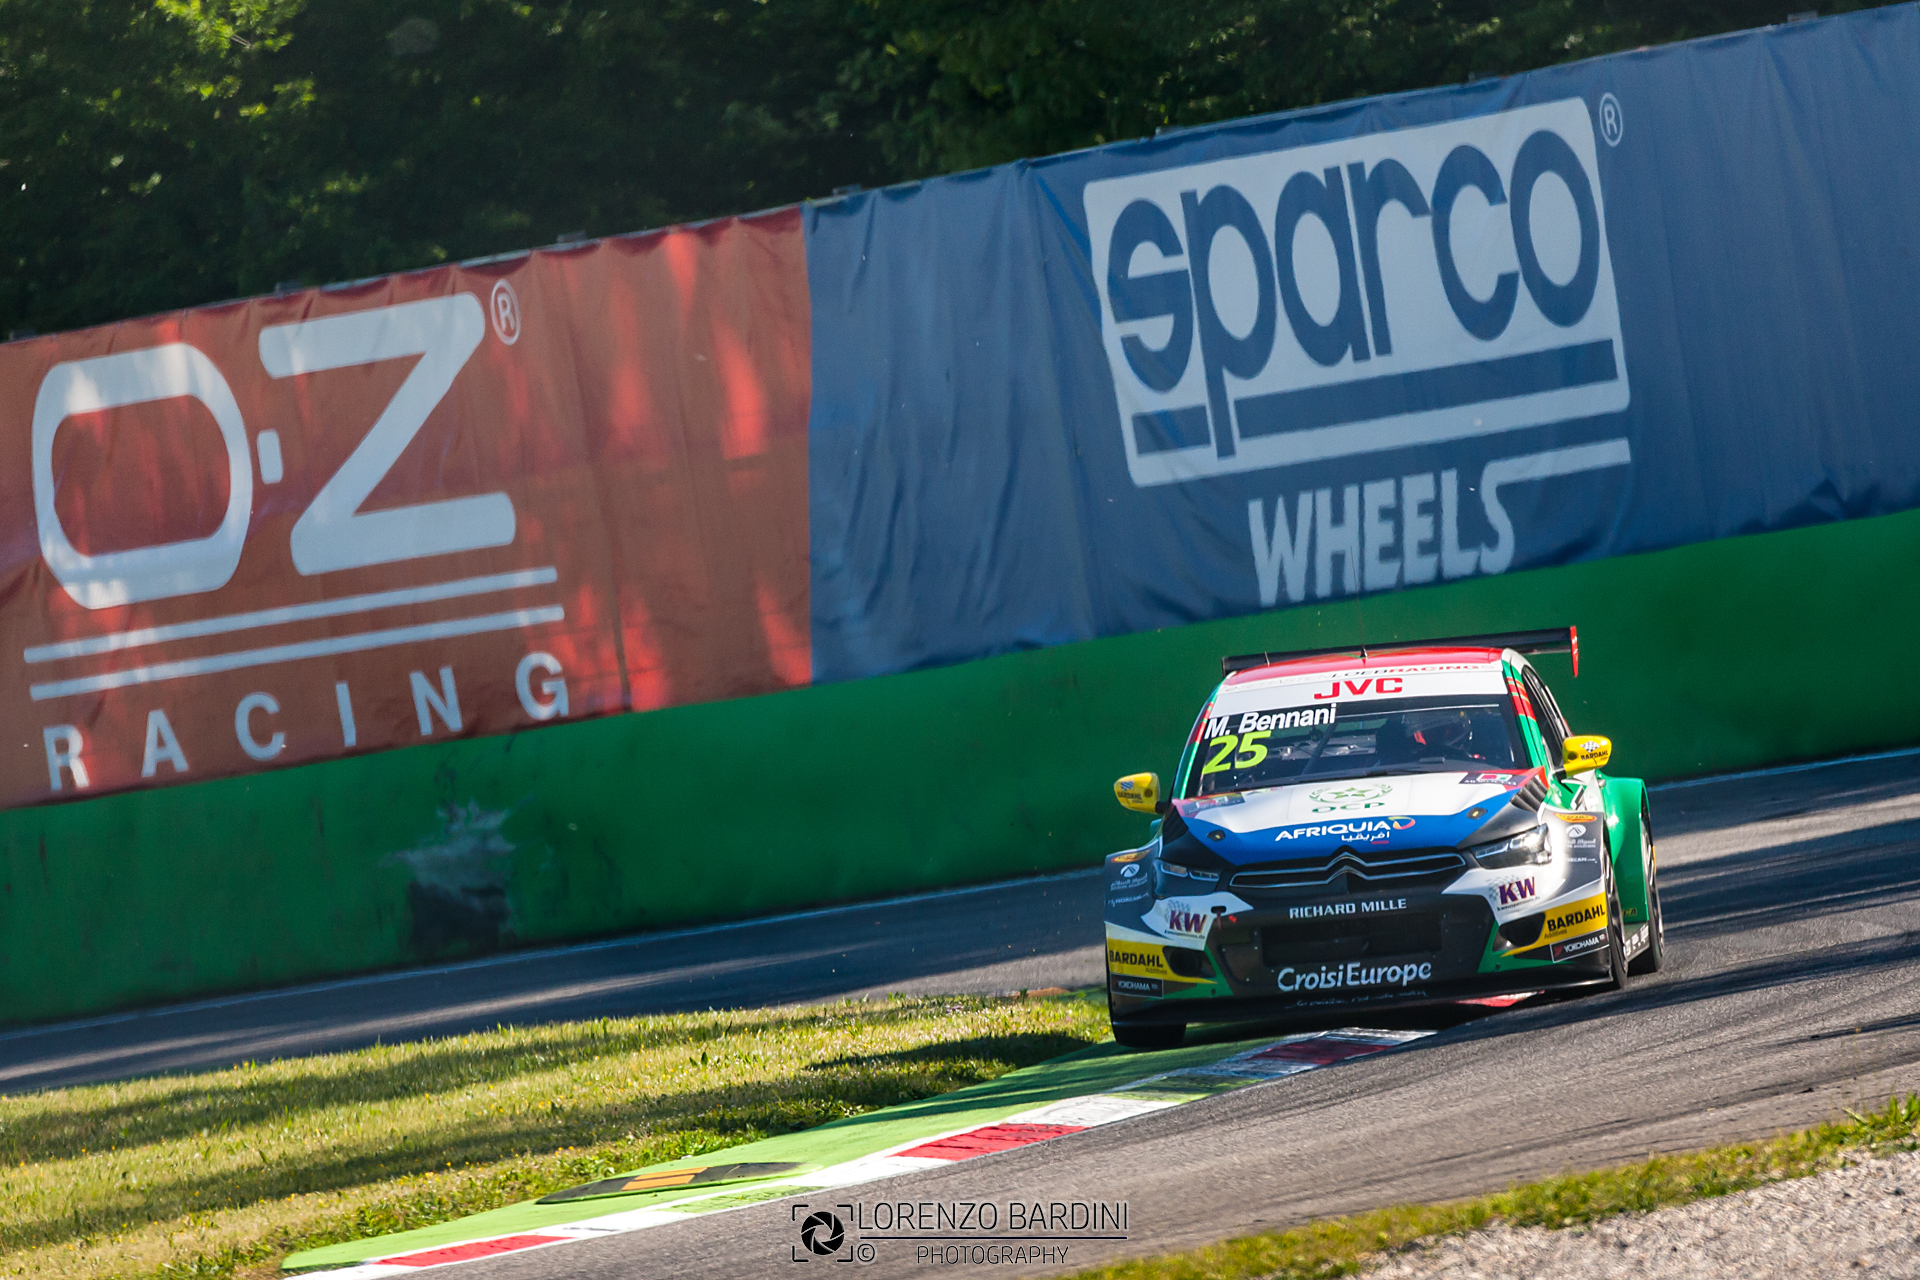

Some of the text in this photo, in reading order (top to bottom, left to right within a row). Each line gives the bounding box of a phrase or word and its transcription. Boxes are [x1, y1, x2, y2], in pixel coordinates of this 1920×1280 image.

[1106, 129, 1600, 459] sparco
[1247, 438, 1631, 607] WHEELS
[1313, 677, 1403, 700] JVC
[42, 651, 570, 790] RACING
[1204, 703, 1337, 739] M. Bennani
[1201, 730, 1272, 775] 25
[1580, 750, 1609, 761] BARDAHL
[1311, 802, 1385, 813] OCP
[1275, 820, 1391, 842] AFRIQUIA
[1498, 876, 1535, 905] KW
[1289, 898, 1407, 919] RICHARD MILLE
[1547, 904, 1606, 931] BARDAHL
[1169, 910, 1208, 934] KW
[1564, 936, 1600, 952] YOKOHAMA
[1109, 950, 1164, 968] BARDAHL
[1277, 962, 1432, 992] CroisiEurope
